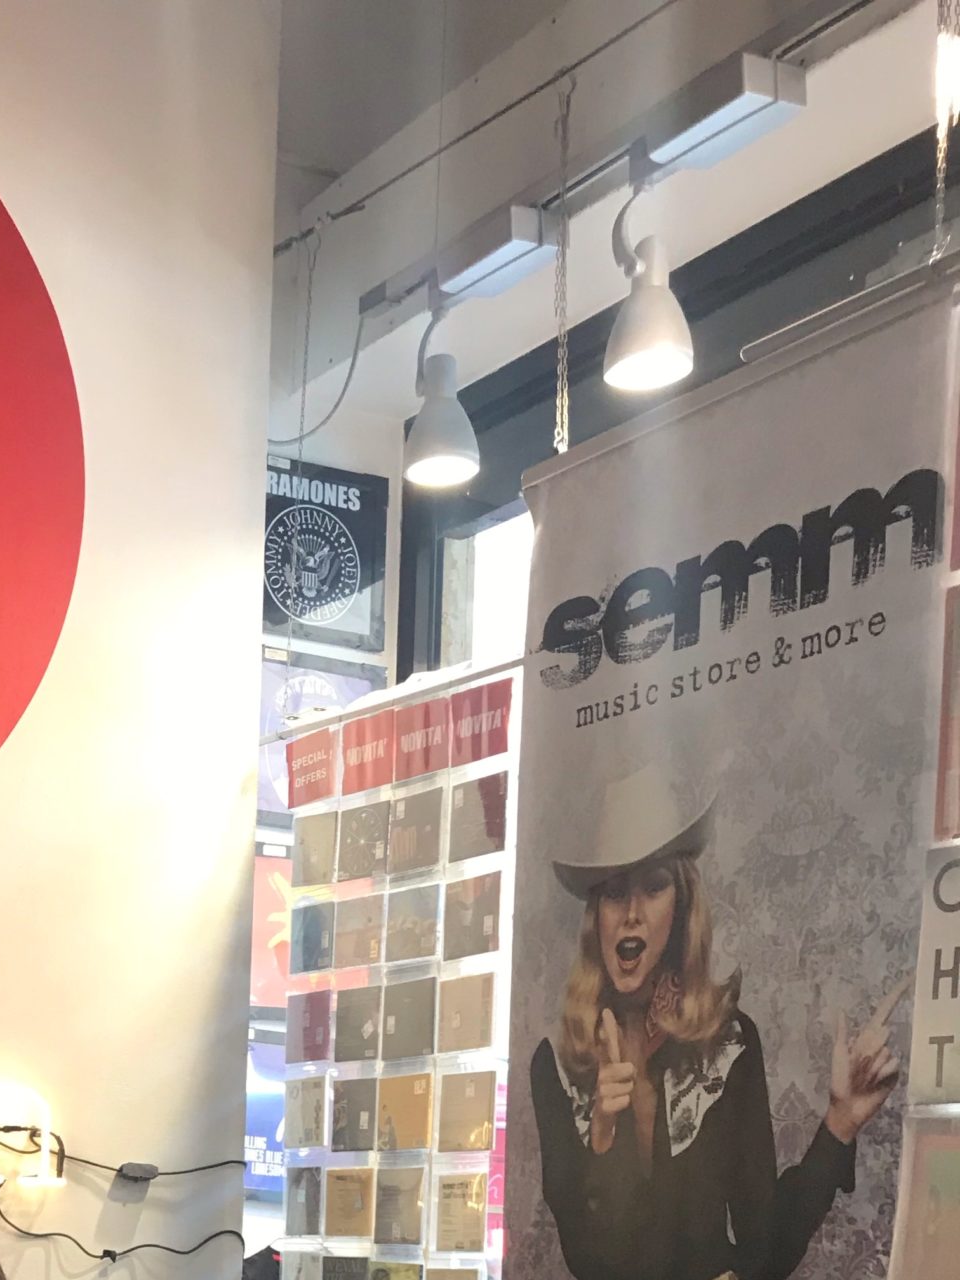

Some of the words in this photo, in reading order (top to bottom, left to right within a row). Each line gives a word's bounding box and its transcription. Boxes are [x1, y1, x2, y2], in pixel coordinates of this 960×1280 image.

[266, 470, 361, 511] RAMONES
[283, 509, 343, 537] JOHNNY
[340, 545, 358, 590] JOEY
[539, 469, 945, 690] semm
[576, 683, 659, 728] music
[670, 651, 761, 699] store
[772, 636, 794, 669] &
[801, 612, 887, 660] more
[291, 747, 327, 771] SPECIAL
[295, 767, 327, 788] OFFERS
